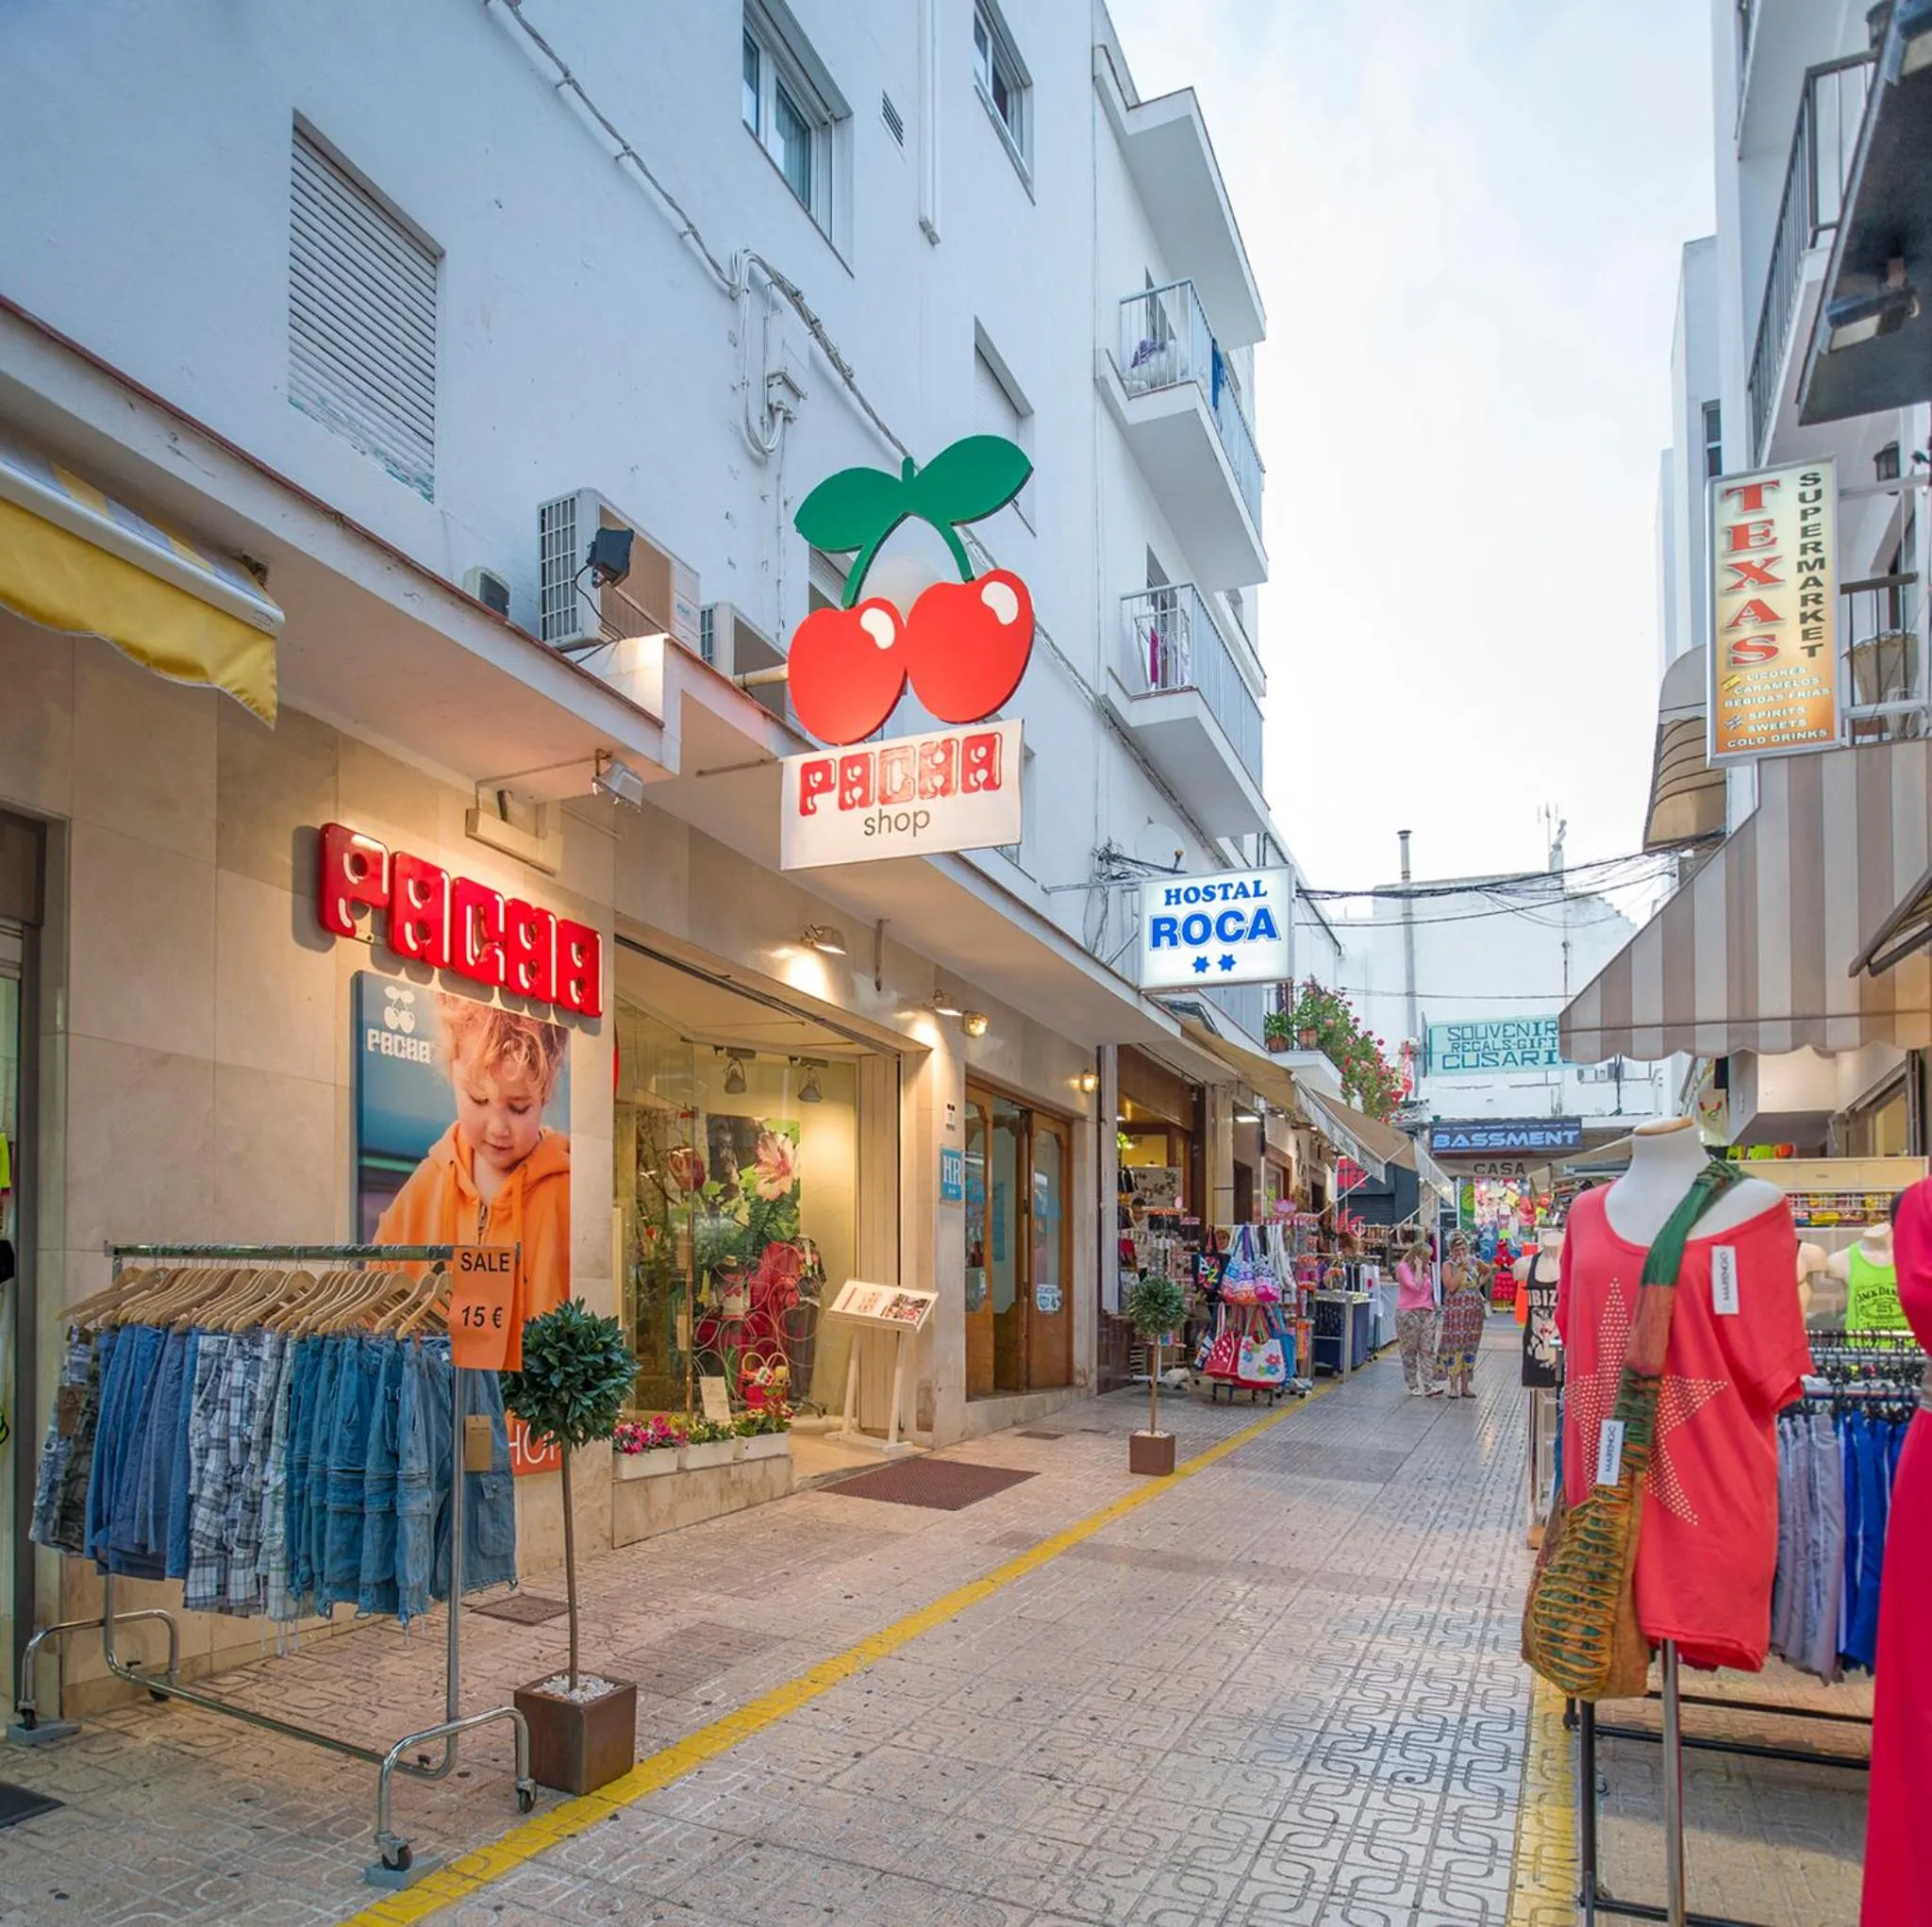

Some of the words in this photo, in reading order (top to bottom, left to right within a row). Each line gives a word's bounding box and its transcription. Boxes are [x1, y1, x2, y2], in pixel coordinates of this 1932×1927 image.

[1723, 479, 1785, 665] TEXAS
[1796, 472, 1825, 658] SUPERMARKET
[1746, 666, 1807, 682] LICORES
[1734, 675, 1821, 695] CARAMELOS
[1724, 693, 1784, 707] BEBIDAS
[1789, 687, 1830, 700] FRIAS
[1747, 705, 1807, 720] SPIRITS
[1746, 718, 1807, 733] SWEETS
[1726, 736, 1767, 748] COLD
[1771, 728, 1828, 743] DRINKS
[799, 731, 1003, 817] PACHA
[863, 807, 930, 837] shop
[1163, 878, 1268, 906] HOSTAL
[319, 822, 604, 1019] PACHA
[1149, 905, 1281, 952] ROCA
[367, 1028, 431, 1064] PACHA
[1441, 1049, 1576, 1070] CUSARI
[1433, 1130, 1579, 1148] BASSMENT
[1474, 1161, 1526, 1175] CASA
[460, 1252, 510, 1272] SALE
[461, 1305, 486, 1327] 15
[491, 1305, 503, 1329] €
